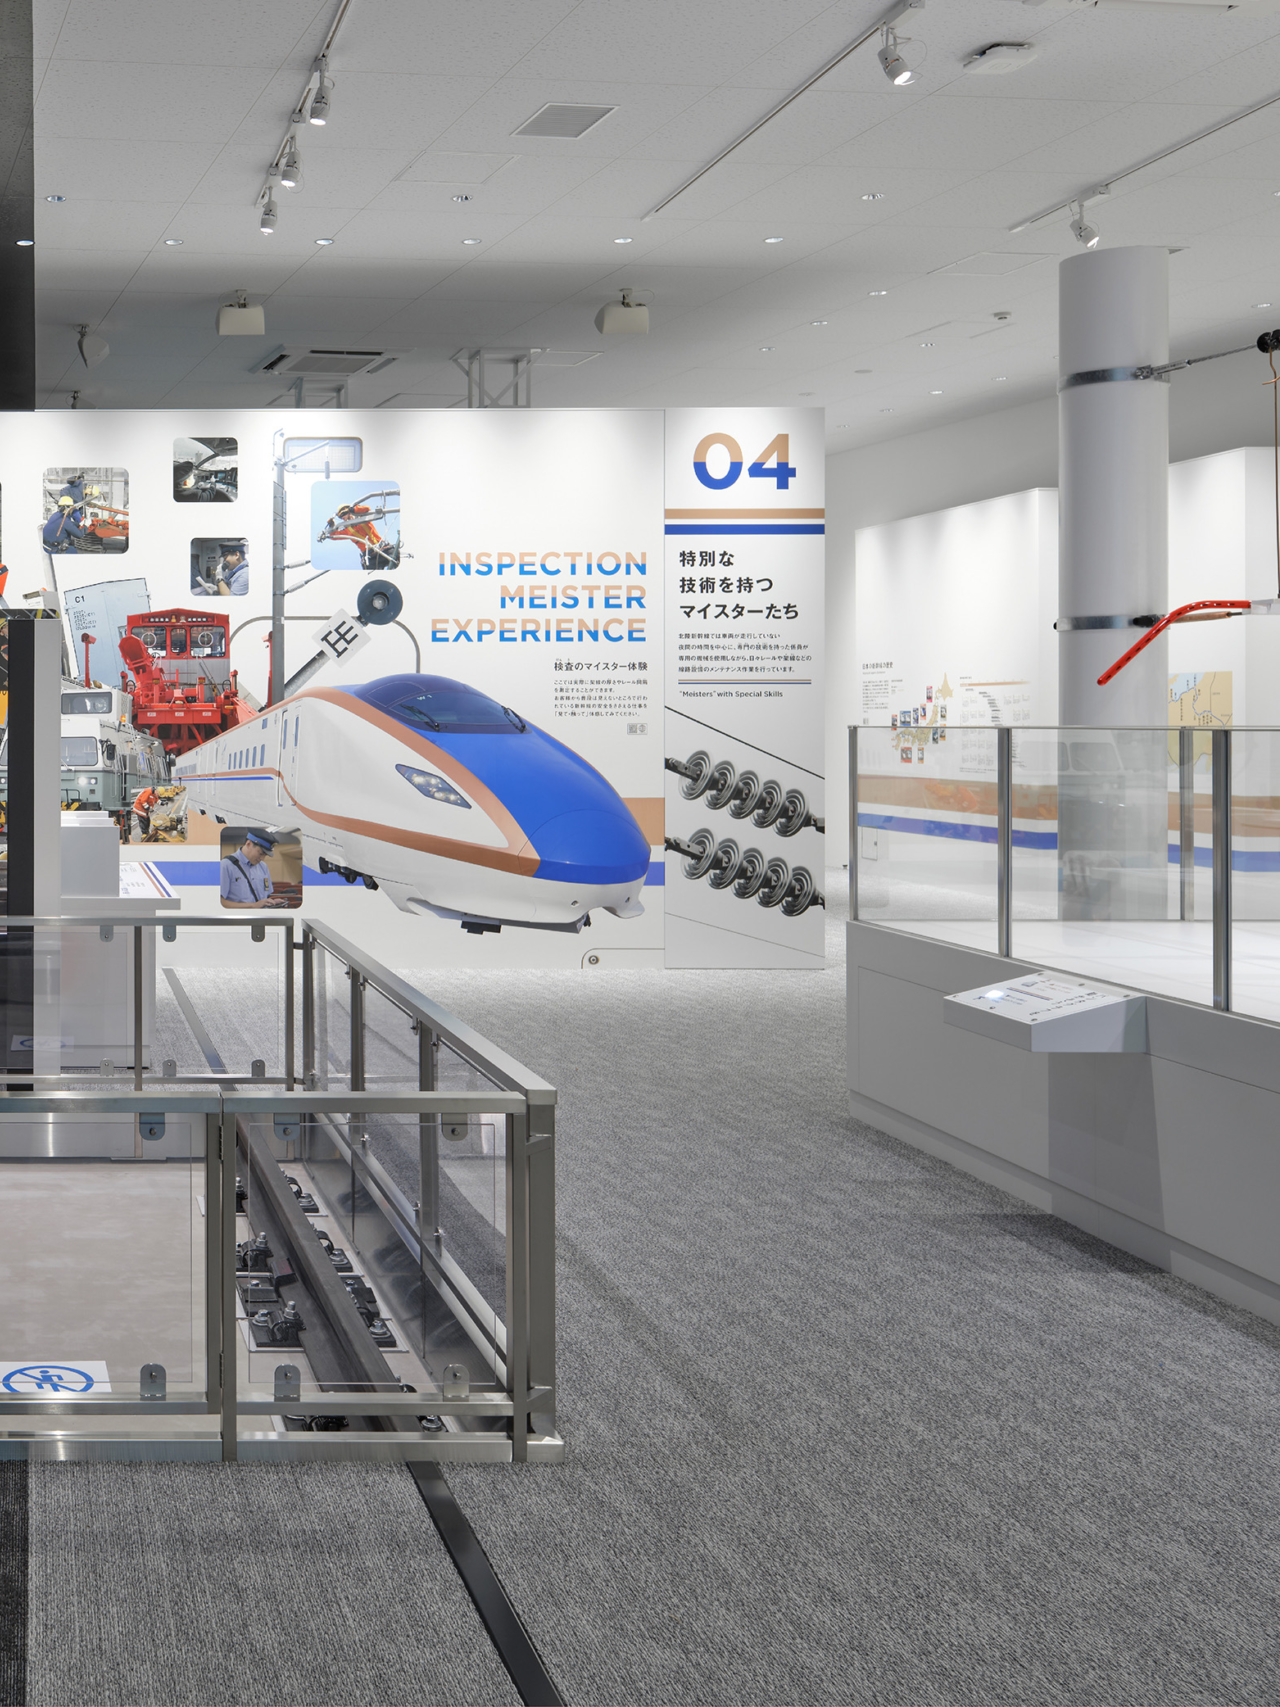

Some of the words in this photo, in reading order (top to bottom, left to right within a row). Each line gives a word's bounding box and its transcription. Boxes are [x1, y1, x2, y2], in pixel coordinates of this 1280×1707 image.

[693, 432, 797, 491] 04
[439, 551, 647, 576] INSPECTION
[679, 550, 735, 568] 特別な
[679, 577, 774, 594] 技術を持つ
[74, 595, 85, 604] C1
[500, 585, 647, 610] MEISTER
[679, 603, 799, 620] マイスターたち
[431, 618, 647, 642] EXPERIENCE
[554, 661, 648, 671] 検査のマイスター体験
[735, 690, 762, 699] Special
[764, 690, 783, 698] Skills
